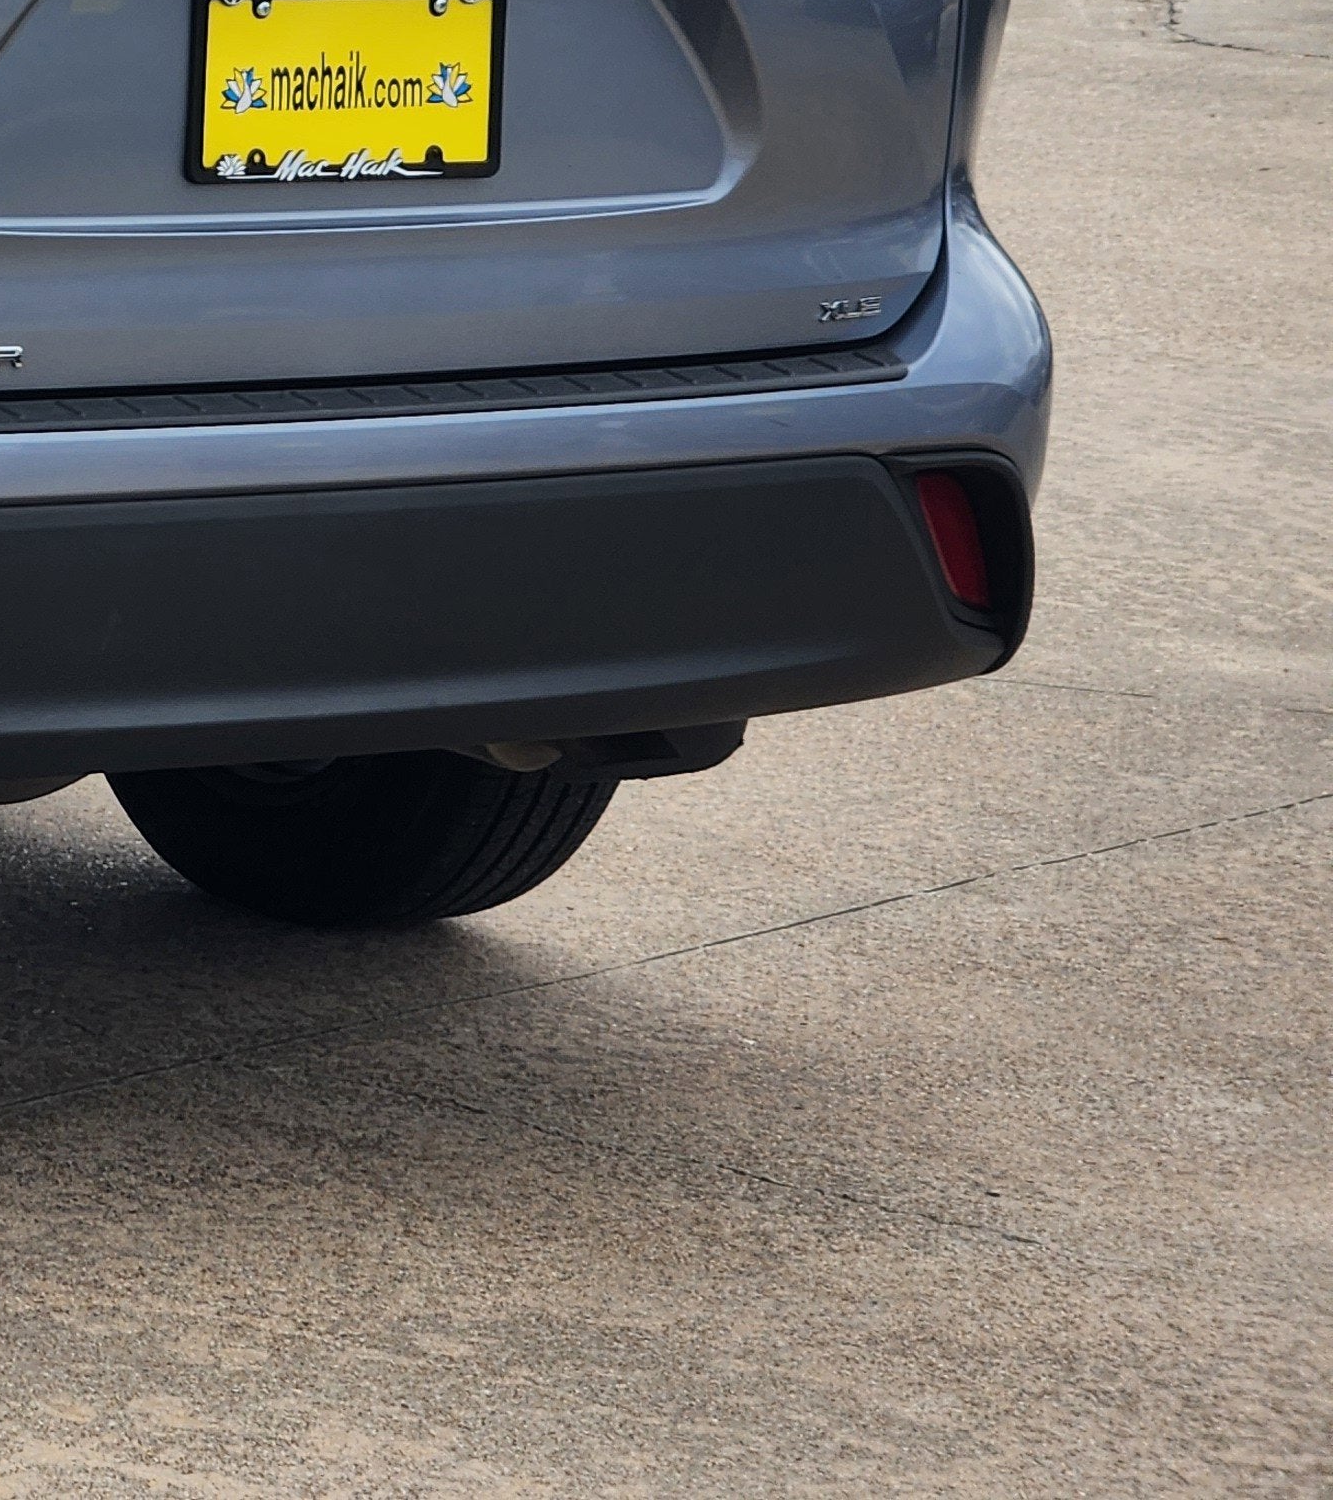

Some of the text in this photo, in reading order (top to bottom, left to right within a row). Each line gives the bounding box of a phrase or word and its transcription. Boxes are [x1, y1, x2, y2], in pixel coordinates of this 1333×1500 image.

[270, 50, 424, 112] machaik.com
[276, 148, 407, 182] Mac Haik
[818, 296, 882, 323] XLE
